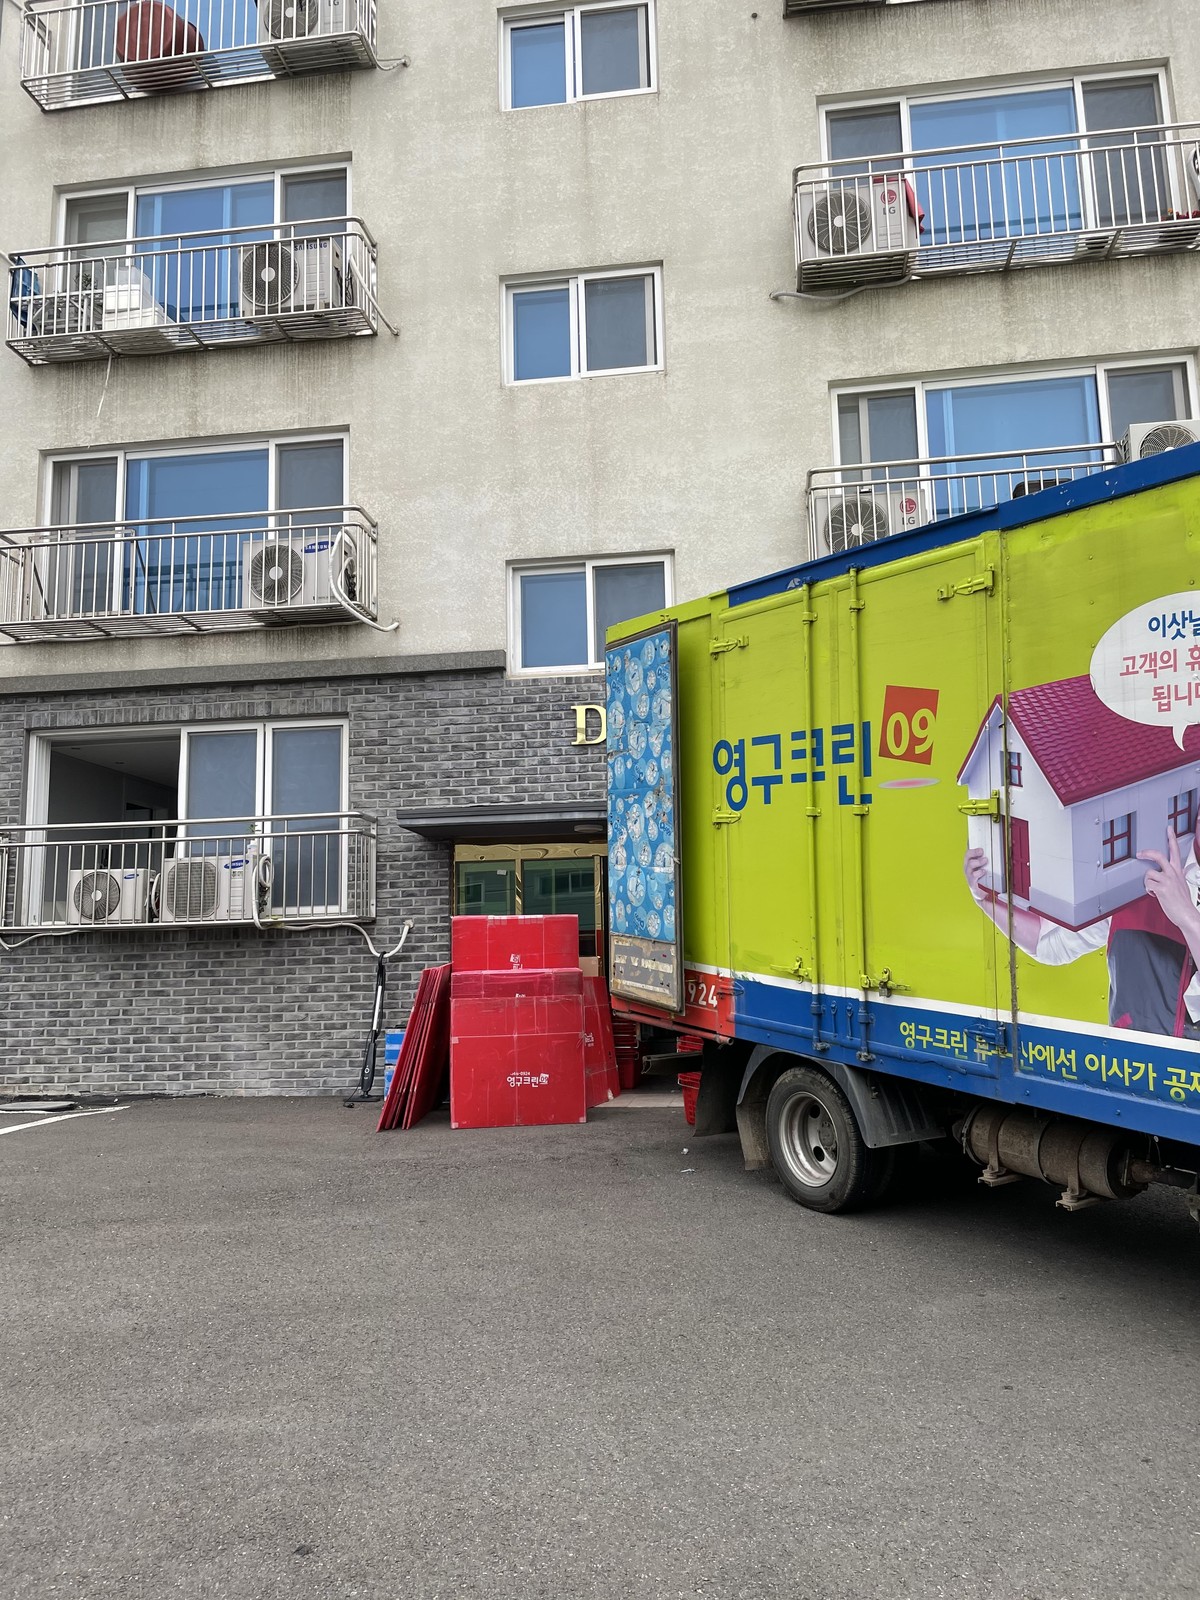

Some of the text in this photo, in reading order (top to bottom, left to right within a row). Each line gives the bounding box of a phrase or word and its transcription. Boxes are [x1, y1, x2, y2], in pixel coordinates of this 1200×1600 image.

[883, 207, 896, 215] LG
[294, 243, 328, 251] SAMSUNG
[902, 517, 916, 525] LG
[1119, 649, 1177, 678] 고객의
[1152, 681, 1200, 713] 됩니
[713, 708, 936, 811] 영구크린 09
[899, 1021, 968, 1060] 영구크린
[1084, 1054, 1157, 1092] 이사가
[506, 1076, 539, 1088] 영구크린
